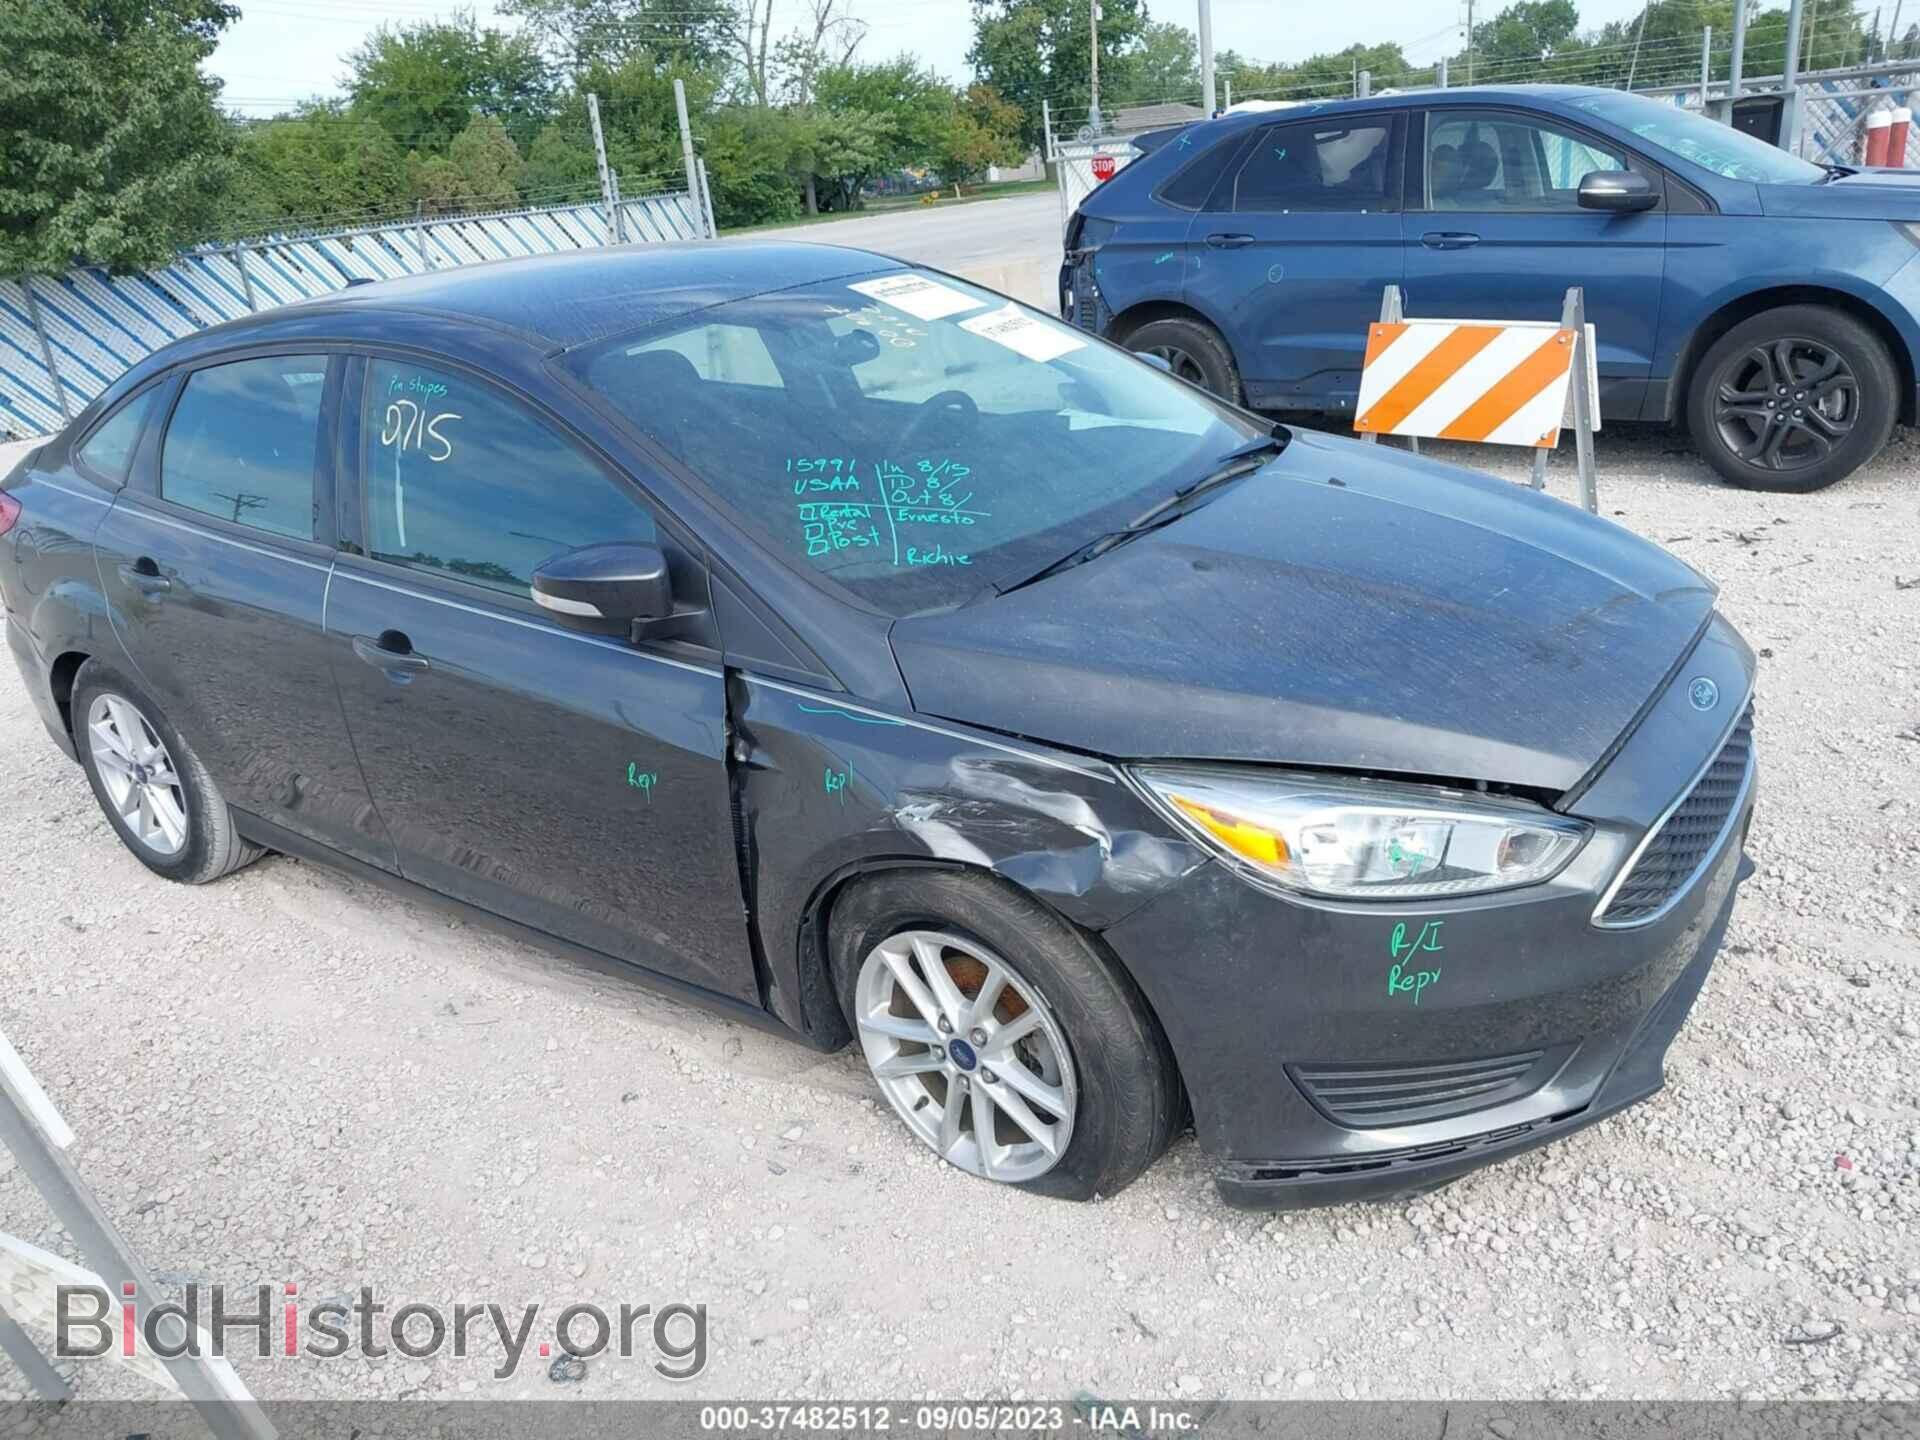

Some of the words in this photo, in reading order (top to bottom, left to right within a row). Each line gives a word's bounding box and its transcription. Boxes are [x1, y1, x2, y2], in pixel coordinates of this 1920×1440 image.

[1093, 160, 1114, 172] STOP
[381, 399, 463, 461] 0715
[794, 474, 859, 495] USAA
[891, 489, 931, 505] Out
[829, 526, 880, 550] Post
[905, 544, 973, 565] Richie
[1391, 921, 1445, 967] R/I
